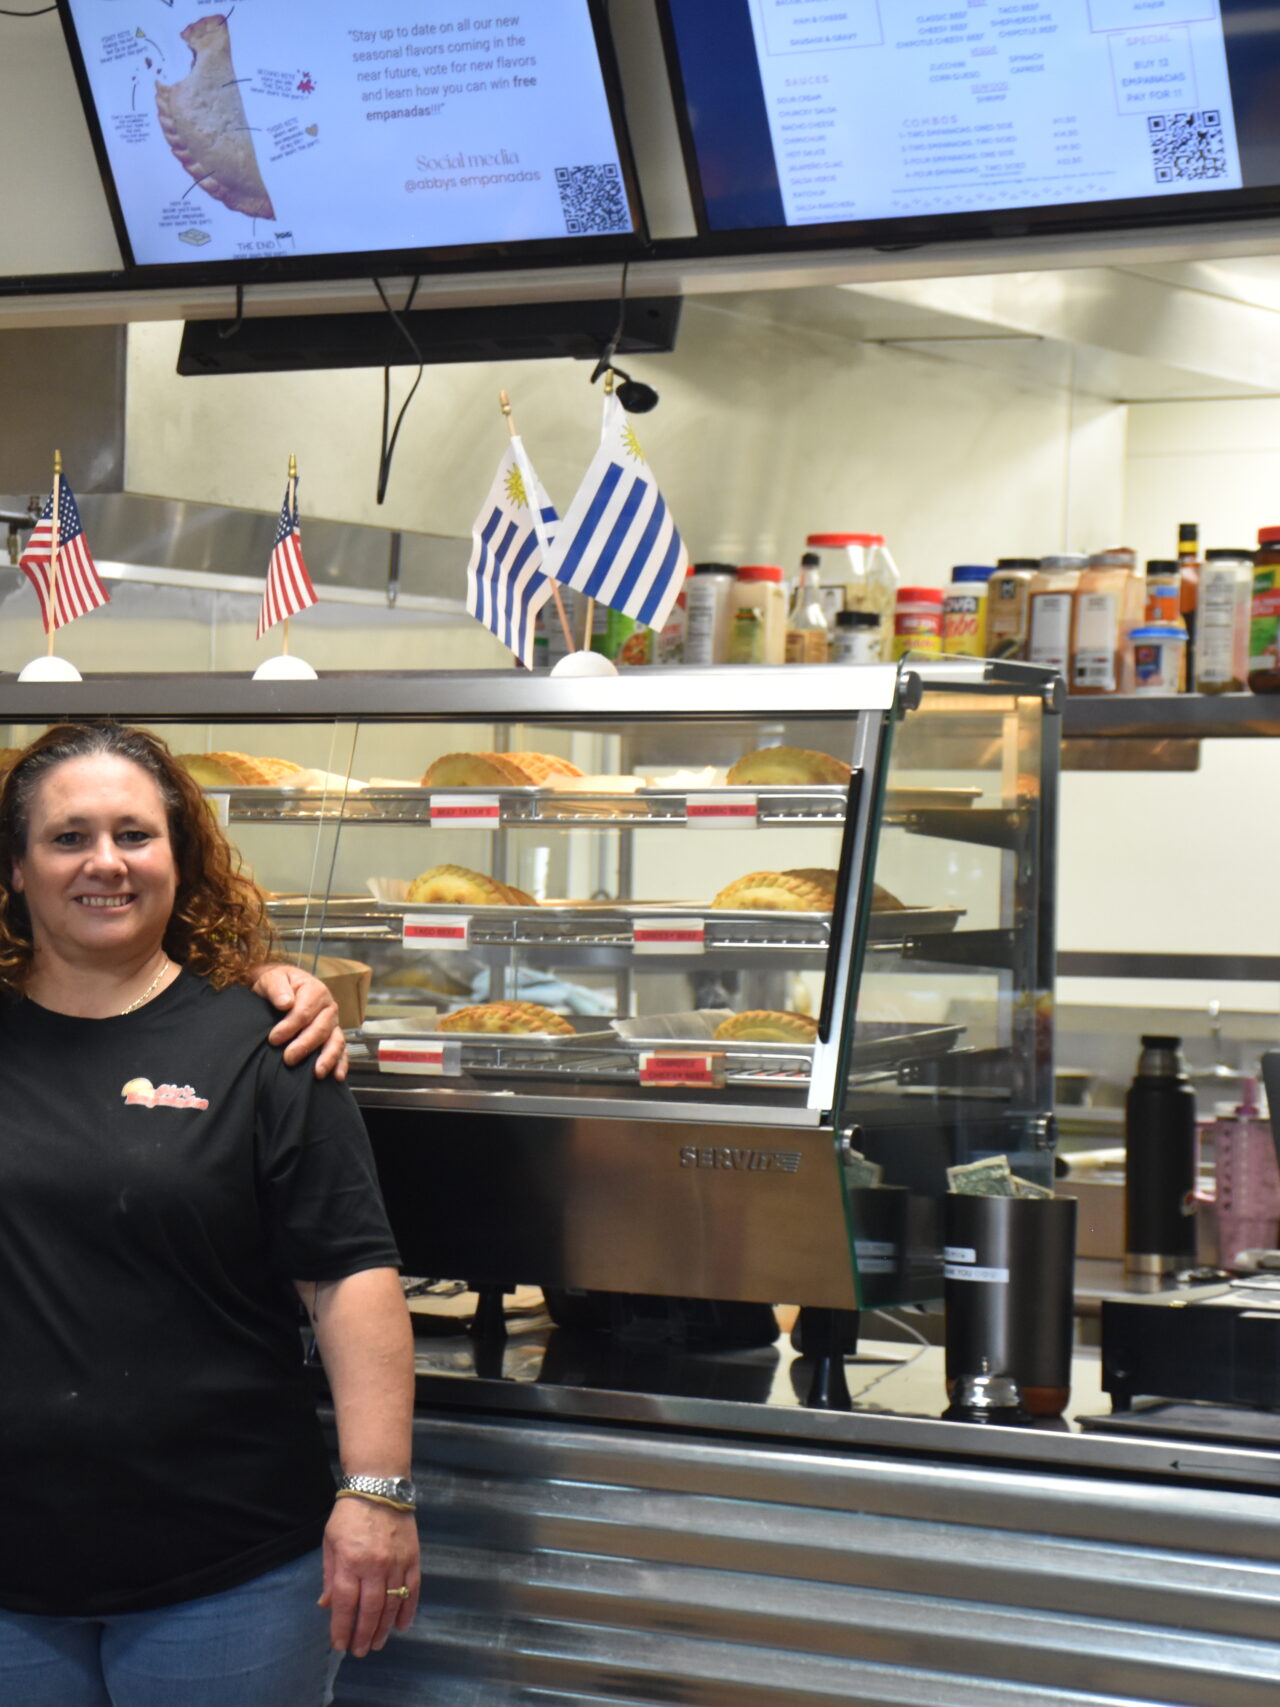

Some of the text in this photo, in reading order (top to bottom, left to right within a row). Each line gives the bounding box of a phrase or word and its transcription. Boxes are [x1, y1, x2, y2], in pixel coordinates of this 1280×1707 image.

[380, 30, 394, 41] up
[397, 26, 408, 38] to
[411, 23, 437, 36] date
[439, 22, 454, 33] on
[457, 18, 471, 32] all
[473, 17, 492, 29] our
[495, 15, 520, 28] new
[352, 34, 526, 63] seasonal flavors coming in the
[357, 54, 537, 82] near future, vote for new flavors
[362, 75, 537, 102] and learn how you can win free
[415, 148, 520, 172] Social media
[460, 169, 541, 188] empanadas
